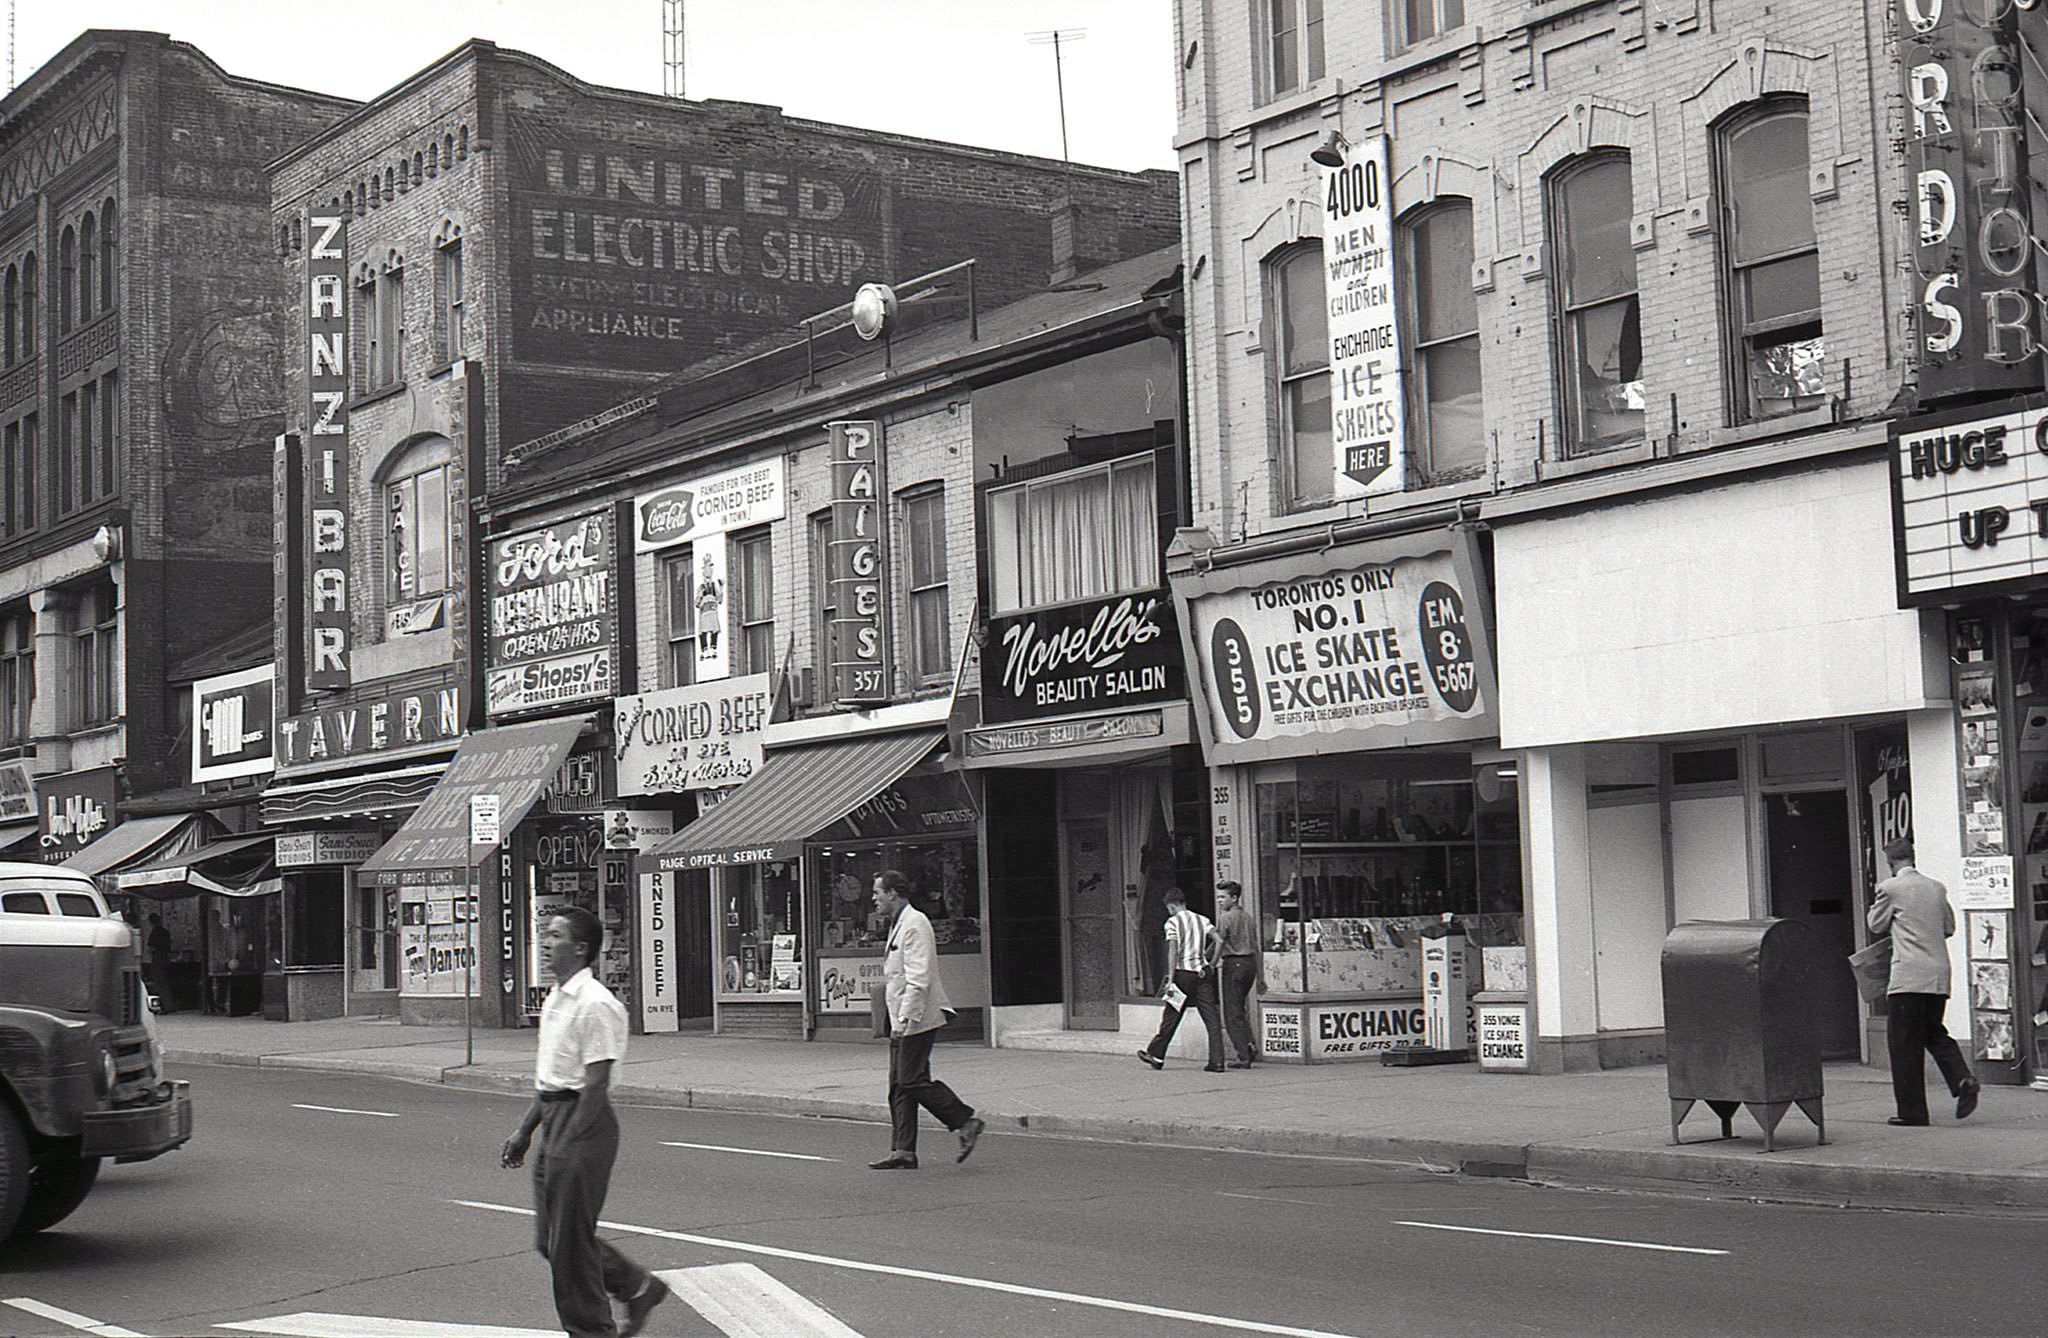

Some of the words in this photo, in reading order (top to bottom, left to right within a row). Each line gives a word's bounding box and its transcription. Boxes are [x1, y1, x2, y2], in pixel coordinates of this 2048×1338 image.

[545, 149, 844, 221] UNITED
[532, 209, 742, 276] ELECTRIC
[761, 231, 865, 286] SHOP
[1334, 224, 1375, 255] MEN
[1330, 247, 1385, 281] WOMEN
[632, 281, 788, 317] ELECTRICAL
[1346, 273, 1370, 291] and
[1330, 283, 1388, 317] CHILDREN
[531, 307, 684, 341] APPLIANCE
[1334, 324, 1394, 361] EXCHANGE
[1341, 360, 1383, 401] ICE
[1335, 400, 1396, 444] SKATES
[311, 216, 347, 673] ZANZIBAR
[1350, 446, 1386, 471] HERE
[1909, 425, 2008, 481] HUGE
[700, 478, 725, 497] FAMOUS
[726, 475, 739, 491] FOR
[753, 468, 771, 486] BEST
[696, 490, 744, 519] CORNED
[746, 482, 775, 505] BEEF
[647, 502, 688, 536] Coca-Cola
[1958, 505, 2010, 551] UP
[1350, 567, 1396, 595] ONLY
[492, 570, 609, 637] RESTAURANT
[503, 632, 549, 660] OPEN
[550, 624, 568, 650] 24
[570, 619, 601, 647] HRS
[1002, 598, 1161, 697] Novello's
[1266, 641, 1307, 676] ICE
[1315, 627, 1401, 669] SKATE
[523, 653, 609, 691] Shopsy's
[853, 670, 882, 692] 357
[1036, 675, 1099, 705] BEAUTY
[1105, 665, 1167, 696] SALON
[1225, 638, 1253, 724] 355
[1266, 662, 1425, 713] EXCHANGE
[1436, 661, 1474, 694] 5667
[523, 686, 556, 704] CORNED
[557, 683, 579, 698] BEEF
[580, 681, 593, 696] ON
[594, 678, 609, 692] RYE
[280, 688, 459, 762] TAVERN
[641, 701, 712, 746] CORNED
[719, 692, 766, 736] BEEF
[442, 752, 499, 785] FORD
[489, 743, 559, 780] DRUGS
[541, 755, 594, 800] UGS
[402, 783, 489, 832] COFFEE
[1214, 787, 1229, 804] 355
[537, 832, 587, 868] OPEN
[585, 829, 601, 868] 2
[641, 826, 670, 836] SMOKED
[320, 850, 375, 865] STUDIOS
[385, 838, 421, 862] WE
[659, 856, 685, 870] PAIGE
[689, 853, 729, 868] OPTICAL
[732, 848, 774, 864] SERVICE
[651, 872, 664, 932] RNED
[653, 938, 665, 998] BEEF
[647, 1005, 660, 1014] ON
[660, 1004, 675, 1014] RYE
[1265, 1014, 1277, 1025] 355
[1277, 1014, 1299, 1025] YONGE
[1319, 1008, 1426, 1040] EXCHANG
[1483, 1015, 1495, 1026] 355
[1496, 1015, 1520, 1026] YONGE
[1265, 1041, 1300, 1054] EXCHANGE
[1267, 1028, 1278, 1039] ICE
[1279, 1027, 1299, 1039] SKATE
[1325, 1043, 1356, 1053] FREE
[1359, 1041, 1391, 1051] GIFTS
[1484, 1030, 1495, 1041] ICE
[1497, 1029, 1519, 1041] SKATE
[1483, 1043, 1524, 1060] EXCHANGE
